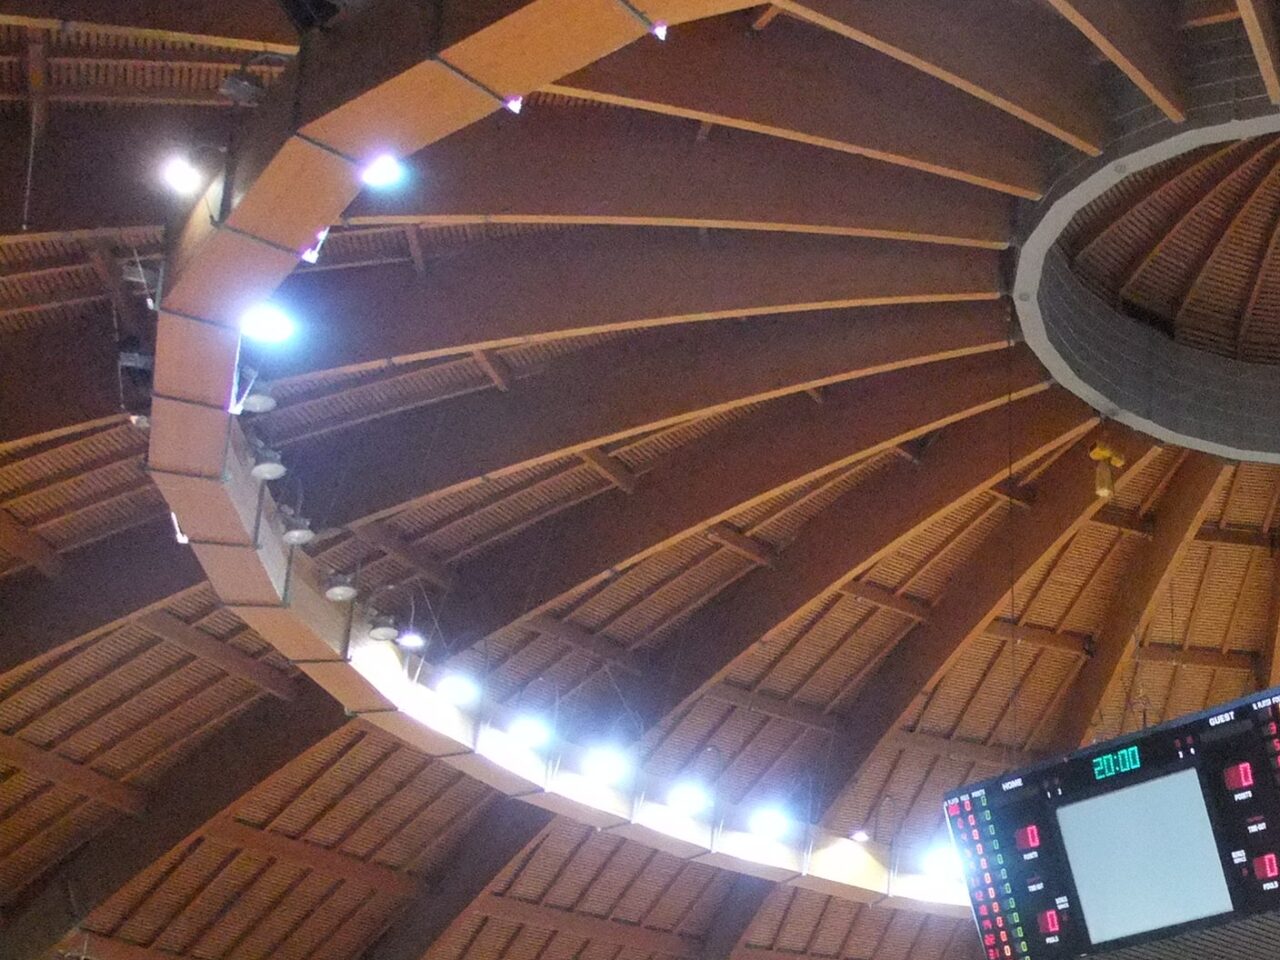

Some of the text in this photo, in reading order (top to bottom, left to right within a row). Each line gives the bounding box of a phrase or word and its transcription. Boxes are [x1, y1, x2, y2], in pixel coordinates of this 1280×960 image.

[1208, 711, 1235, 727] GUEST
[1092, 745, 1141, 780] 20:00
[1239, 762, 1254, 787] 0
[1001, 777, 1023, 792] HOME
[1026, 824, 1040, 848] 0
[1264, 853, 1279, 878] 0
[1046, 909, 1060, 932] 0
